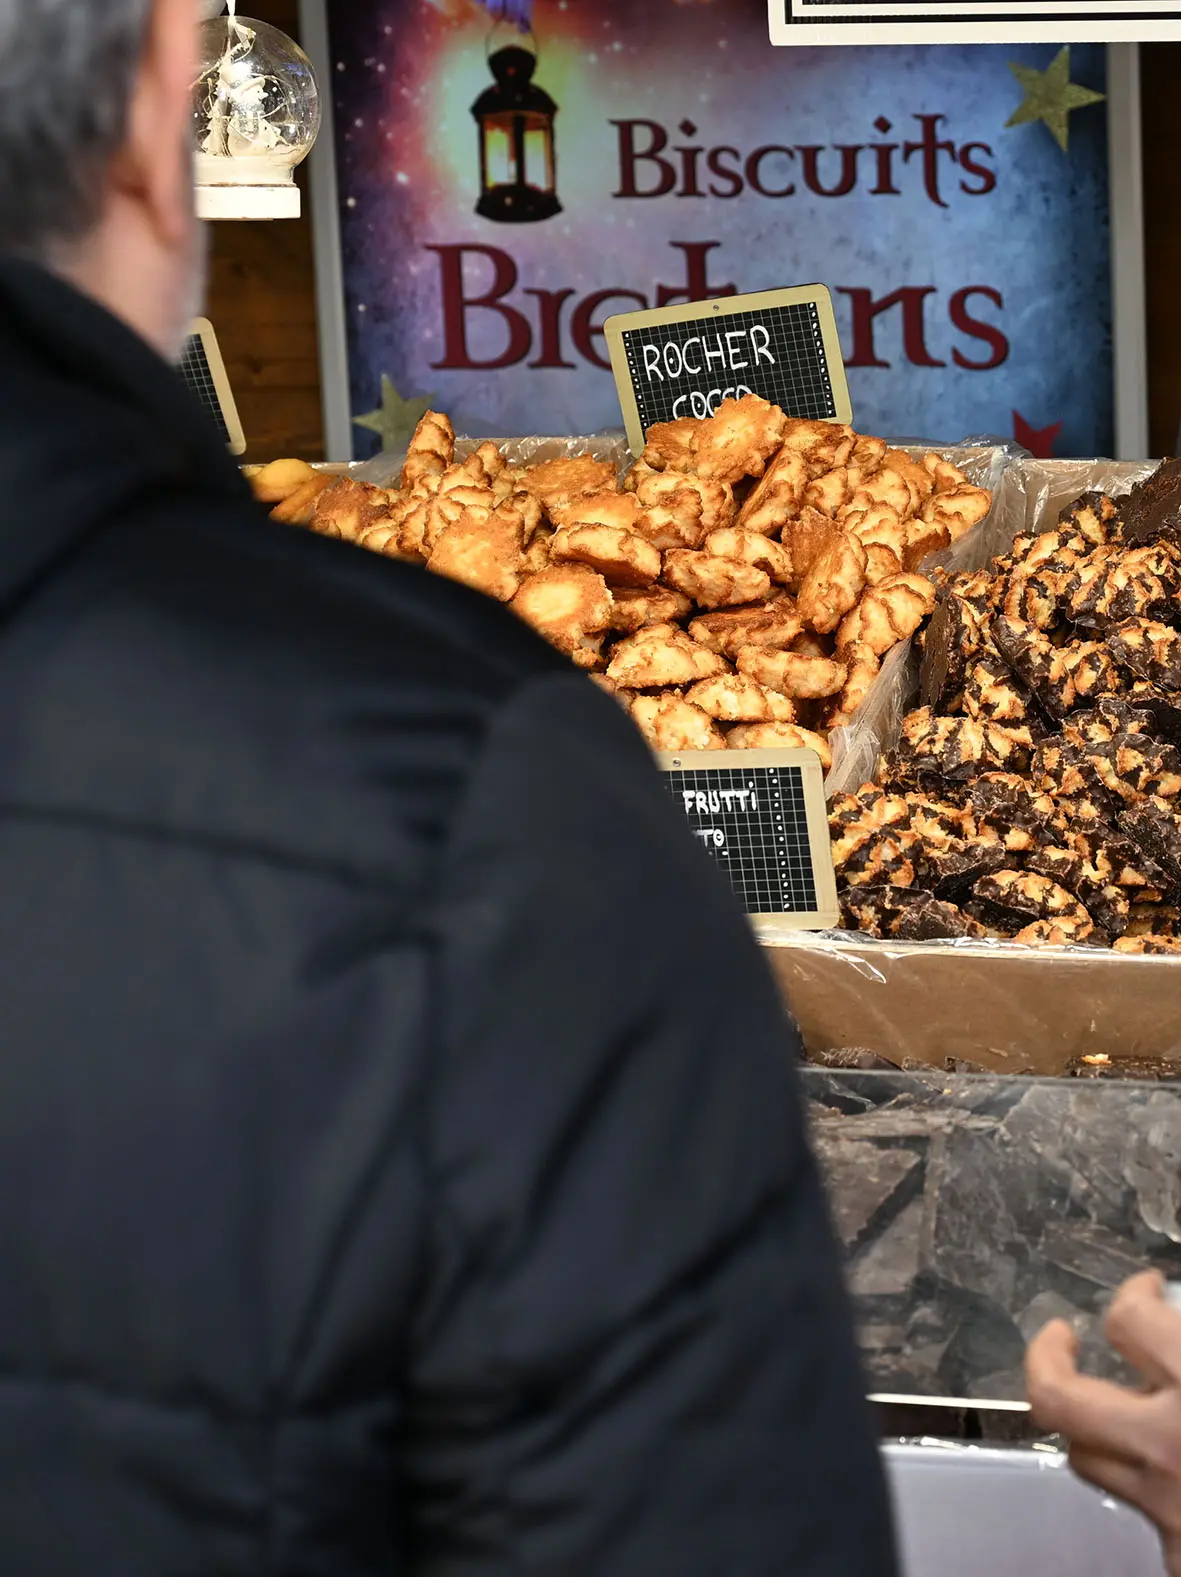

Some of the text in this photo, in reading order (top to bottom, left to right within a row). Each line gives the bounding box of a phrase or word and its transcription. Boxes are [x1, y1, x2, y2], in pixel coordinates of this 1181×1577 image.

[609, 114, 997, 207] Biscuits
[423, 240, 1012, 370] Bretns
[642, 325, 776, 382] ROCHER
